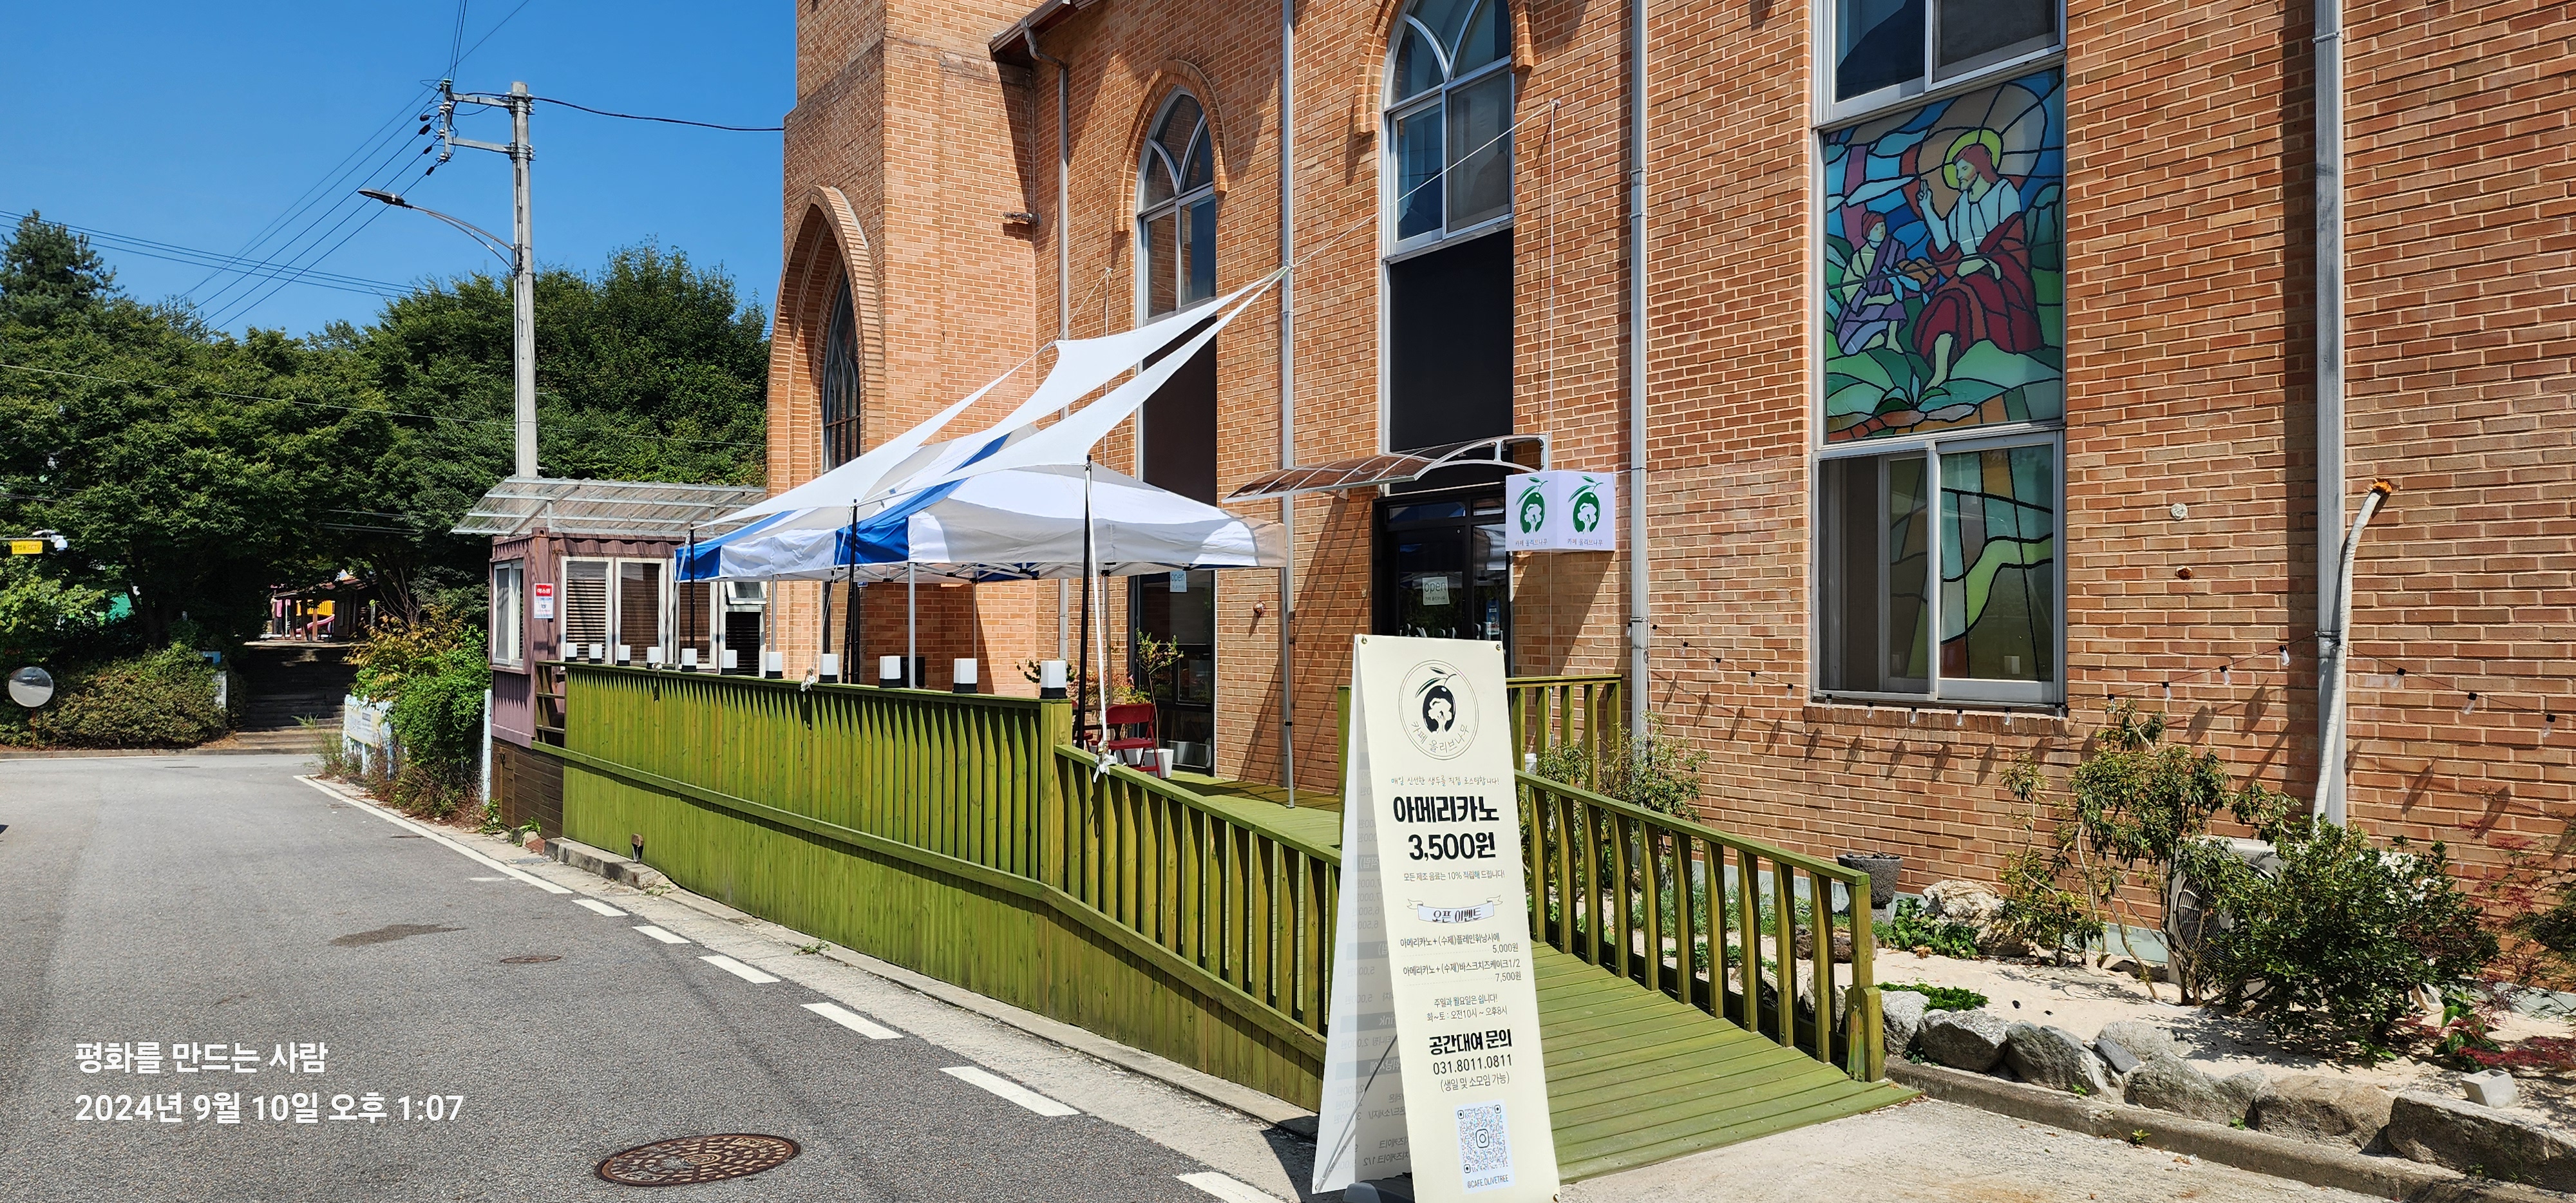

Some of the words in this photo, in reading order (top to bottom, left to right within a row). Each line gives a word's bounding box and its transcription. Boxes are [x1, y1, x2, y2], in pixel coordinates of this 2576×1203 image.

[1425, 582, 1446, 594] open
[1411, 721, 1428, 745] 카페
[1429, 725, 1470, 753] 올리브나무
[1391, 777, 1404, 786] 매일
[1407, 775, 1425, 785] 신선한
[1428, 775, 1446, 786] 생두를
[1448, 777, 1461, 786] 직접
[1464, 775, 1500, 786] 로스팅합니다!
[1393, 795, 1500, 823] 아메리카노
[1408, 831, 1496, 862] 3,500원
[1404, 873, 1416, 882] 모든
[1416, 872, 1428, 881] 제조
[1429, 872, 1446, 880] 음료는
[1448, 871, 1463, 880] 10%
[1463, 870, 1481, 880] 적립해
[1481, 869, 1505, 878] 드립니다!
[1432, 909, 1452, 924] 오픈
[1454, 907, 1482, 923] 이벤트
[1492, 942, 1519, 954] 5,000원
[1495, 971, 1522, 983] 7,500원
[1434, 997, 1452, 1009] 주일과
[1453, 996, 1477, 1007] 월요일은
[1478, 993, 1498, 1004] 쉽니다!
[1427, 1012, 1446, 1023] 화~토
[1451, 1008, 1477, 1019] 오전10시
[1485, 1005, 1508, 1016] 오후8시
[1429, 1032, 1484, 1056] 공간대여
[1485, 1028, 1513, 1050] 문의
[1433, 1054, 1512, 1075] 031.8011.0811
[1440, 1078, 1459, 1093] (생일
[1459, 1077, 1468, 1090] 및
[1469, 1074, 1491, 1087] 소모임
[1492, 1071, 1510, 1085] 가능)
